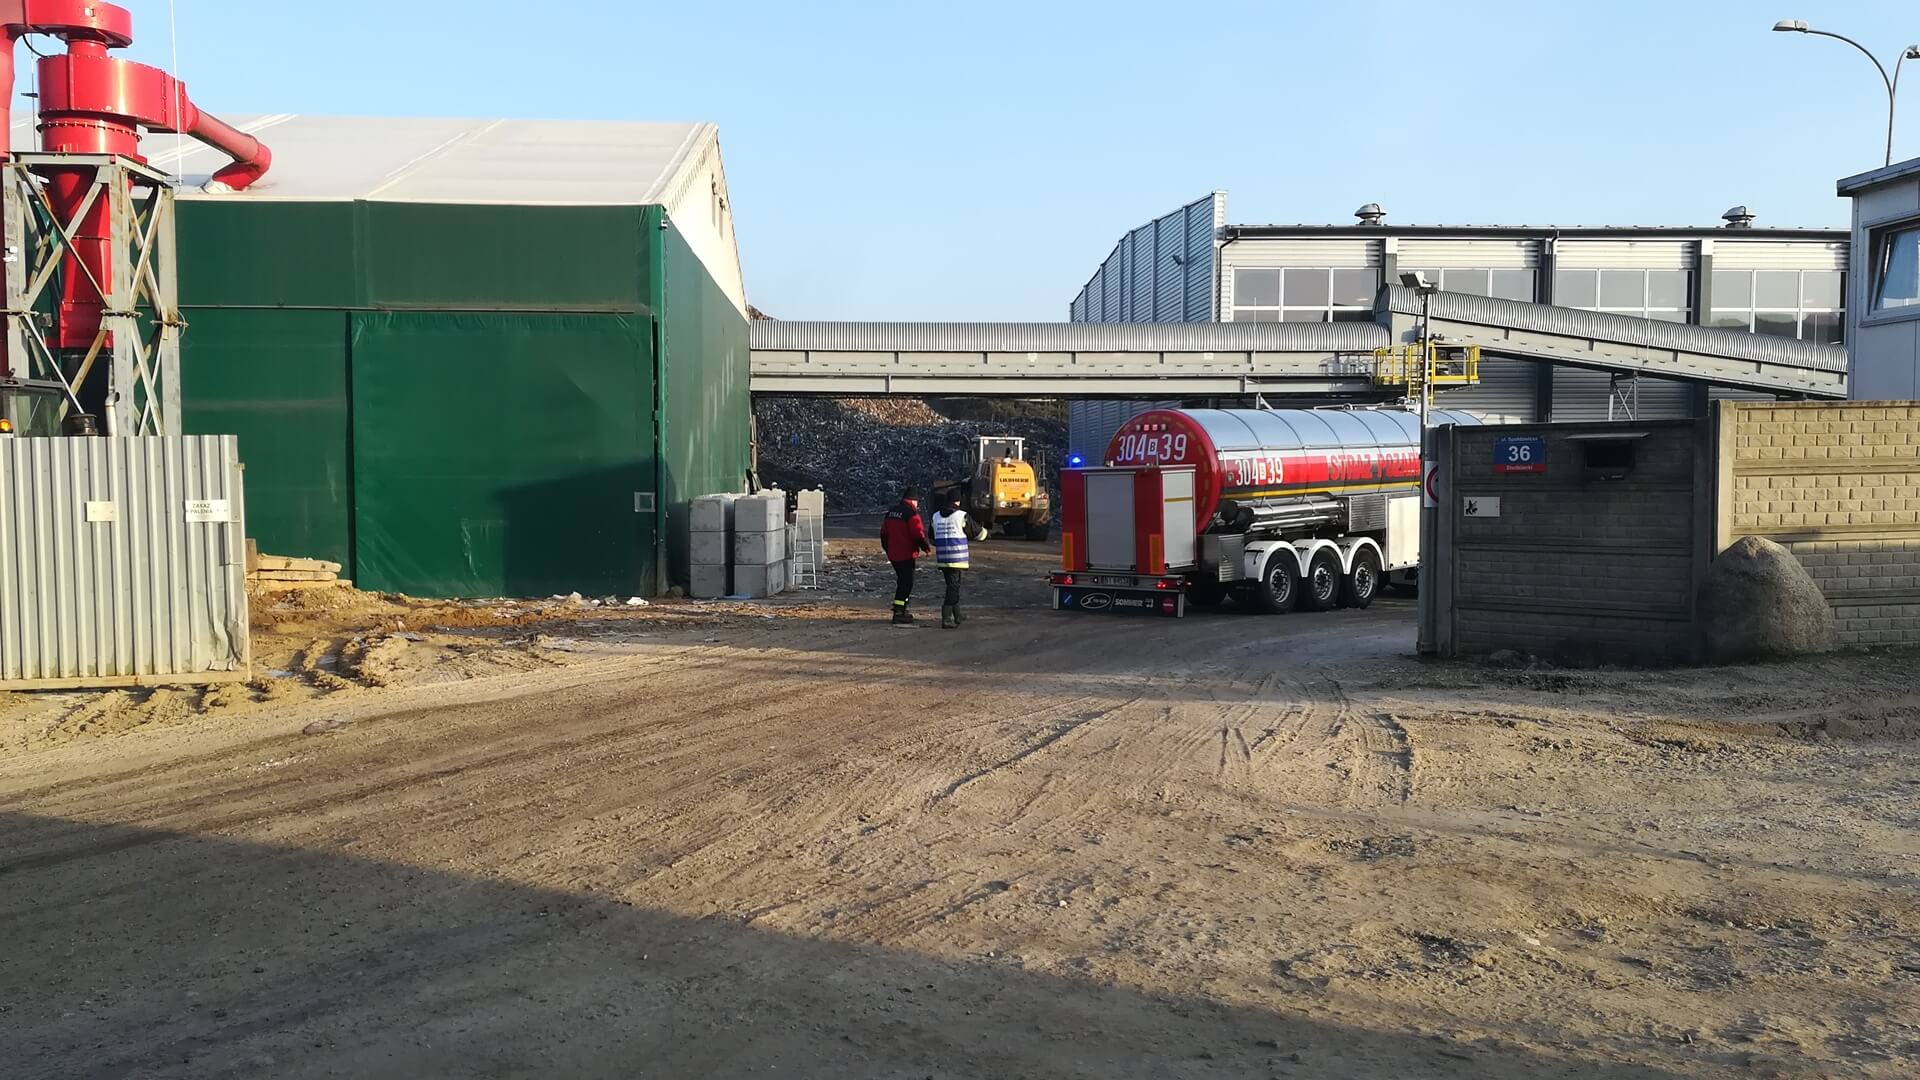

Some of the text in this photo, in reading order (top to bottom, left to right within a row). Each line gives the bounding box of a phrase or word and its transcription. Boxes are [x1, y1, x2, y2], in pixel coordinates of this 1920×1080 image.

[1117, 433, 1147, 461] 304
[1159, 433, 1187, 461] 39
[1508, 445, 1530, 461] 36
[1235, 458, 1258, 486] 304
[1266, 457, 1283, 484] 39
